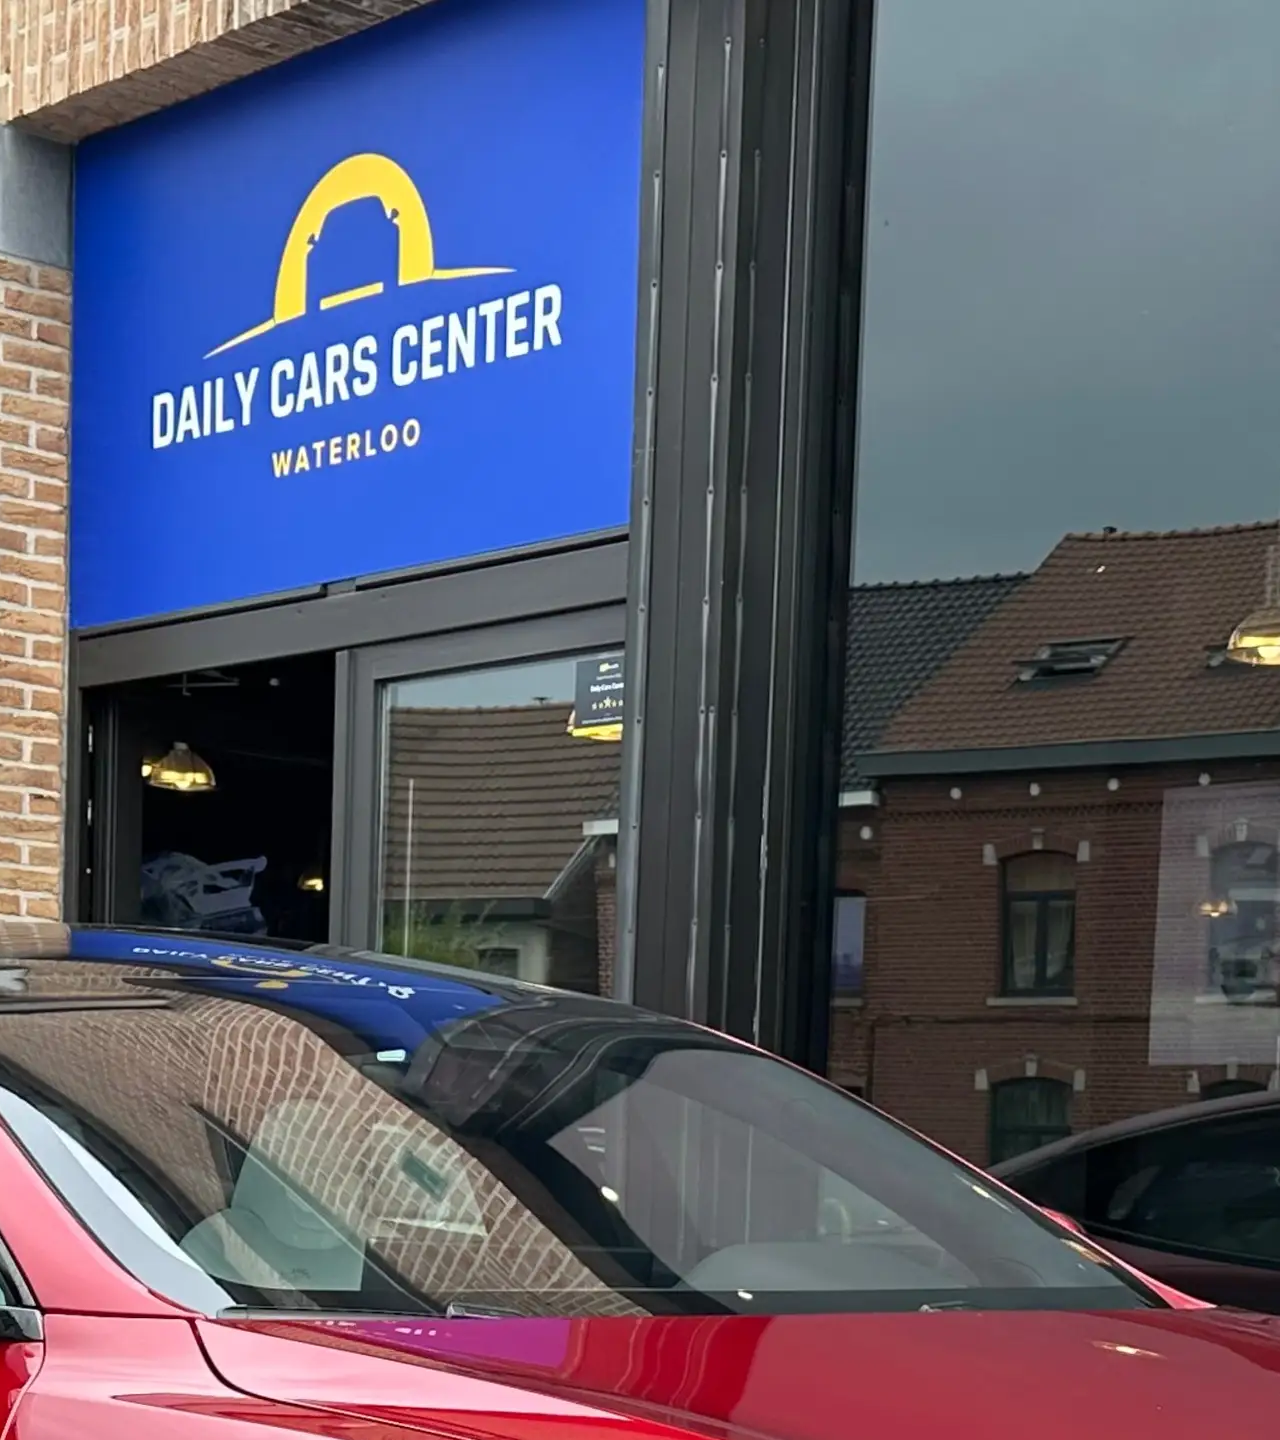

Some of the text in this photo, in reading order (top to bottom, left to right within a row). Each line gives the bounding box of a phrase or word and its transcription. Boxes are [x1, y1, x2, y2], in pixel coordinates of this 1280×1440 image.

[153, 283, 562, 448] DAILY CARS CENTER
[272, 418, 421, 478] WATERLOO
